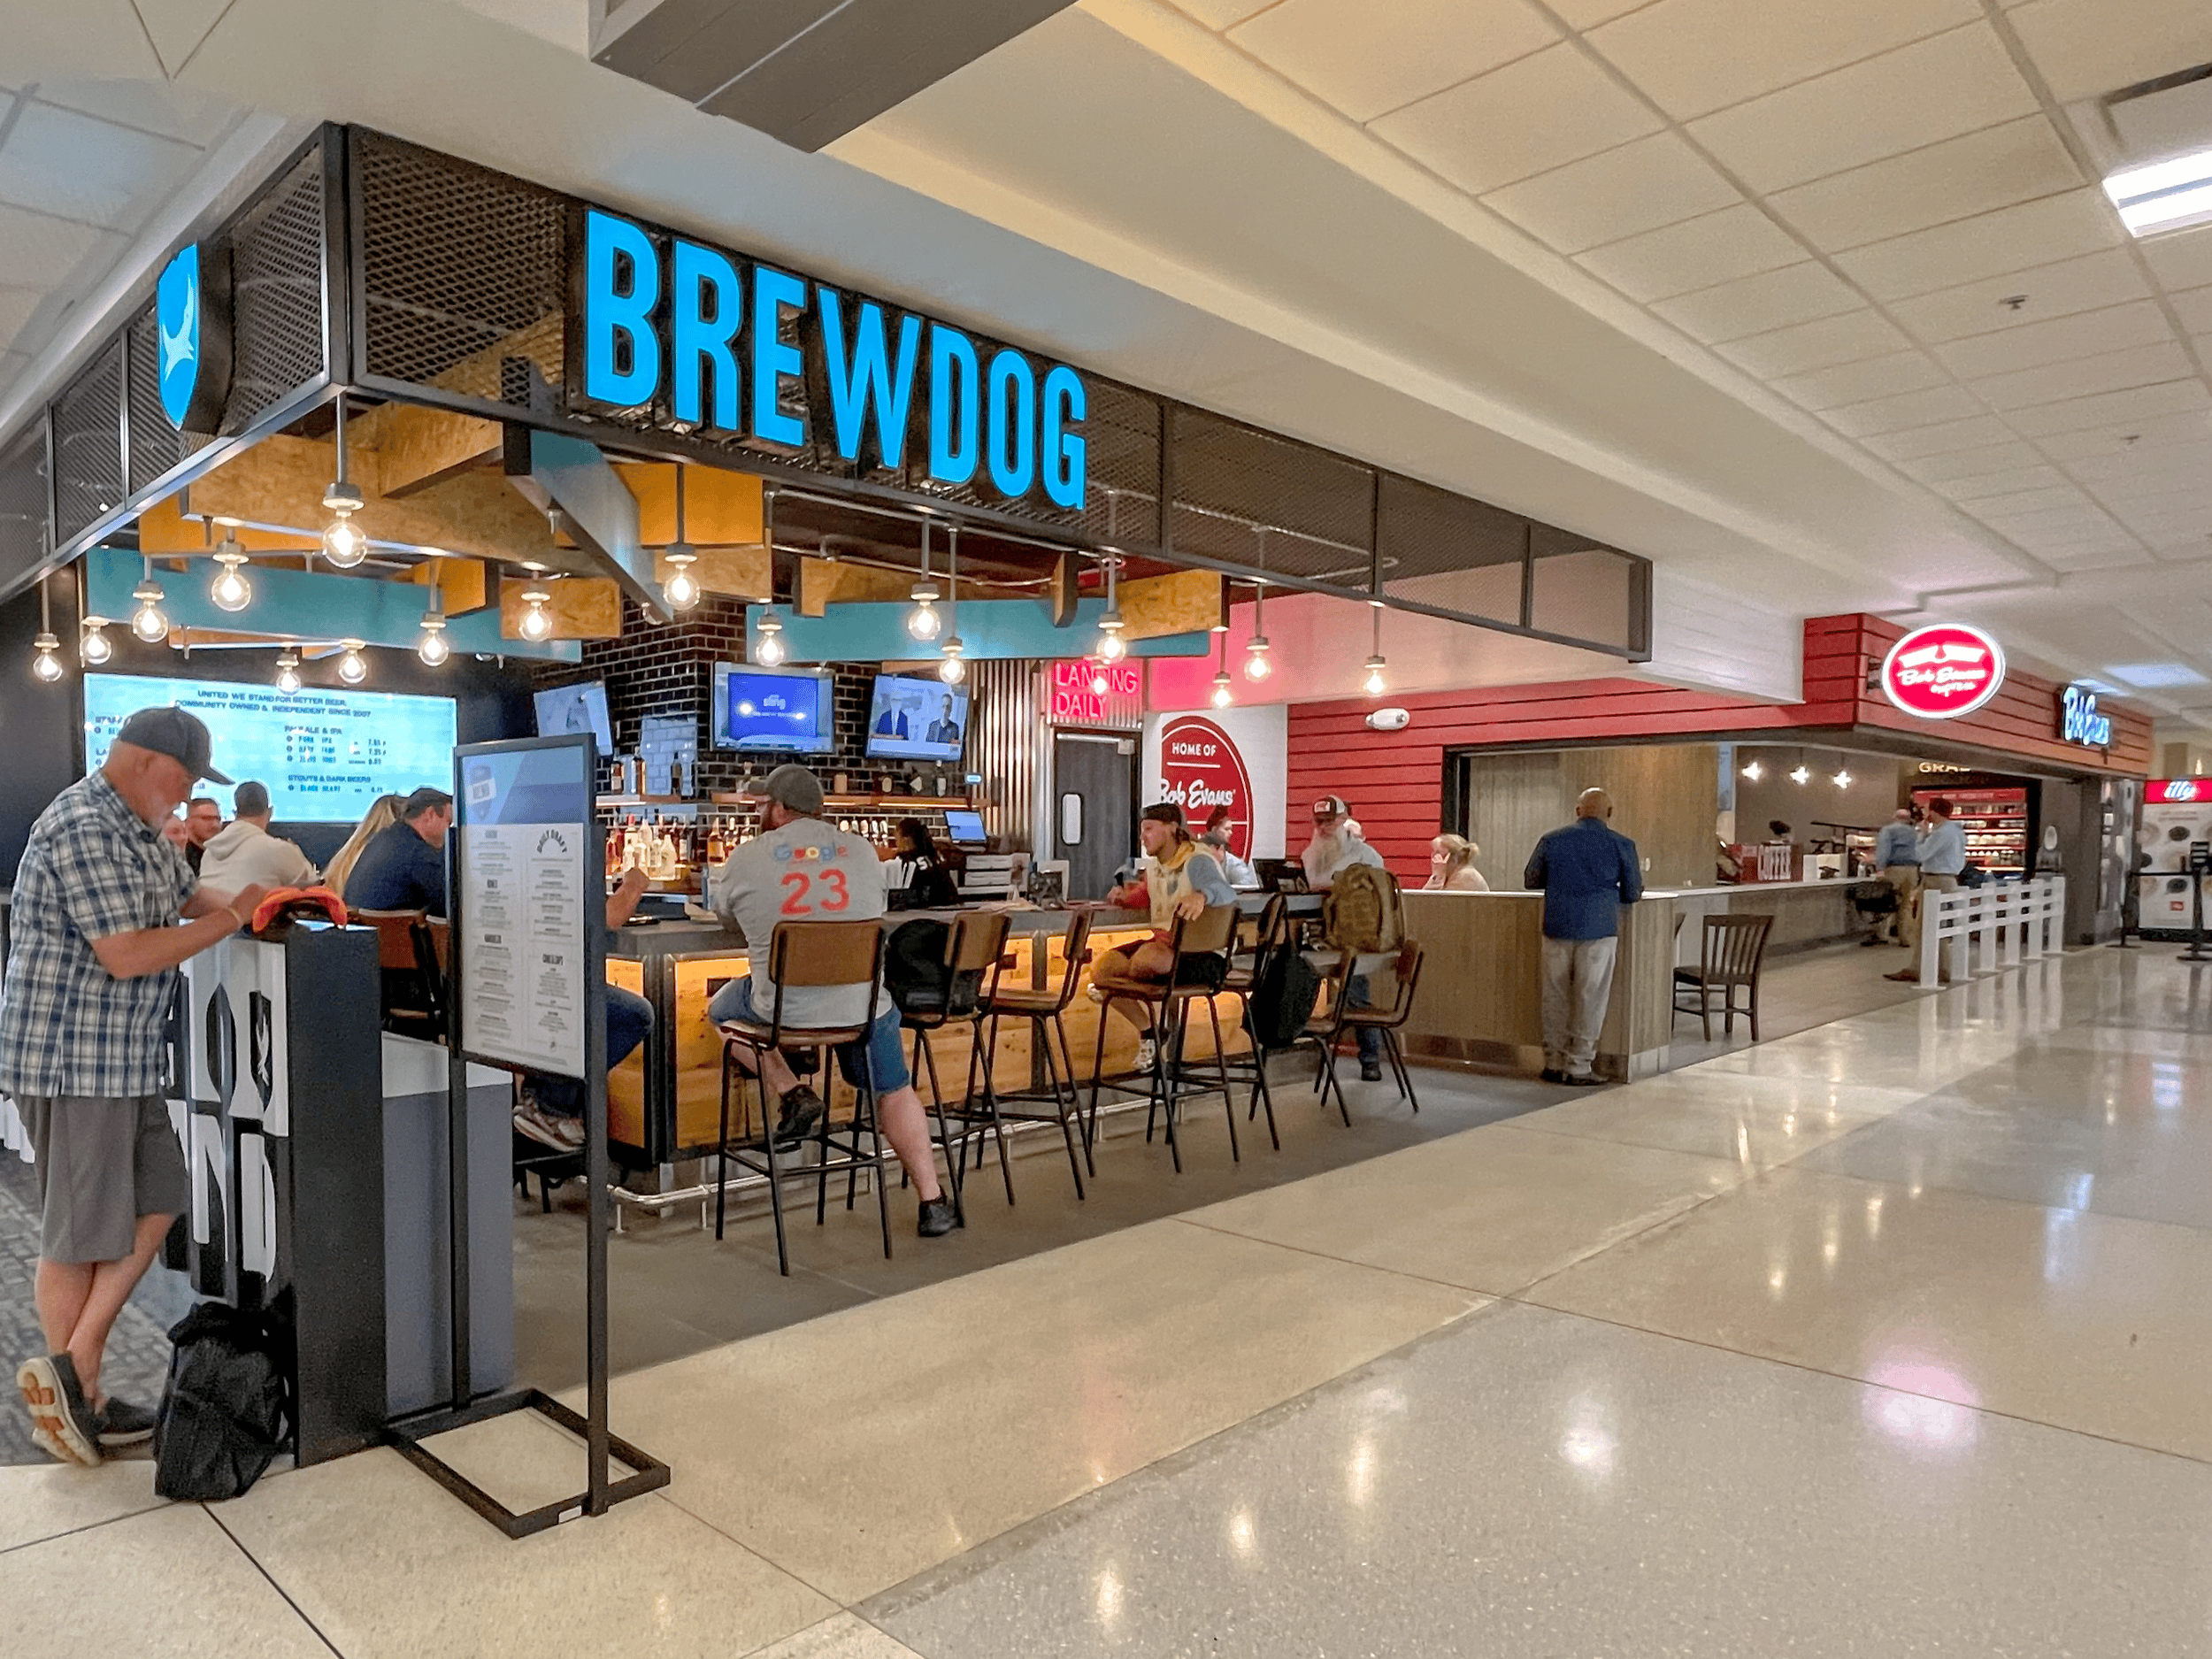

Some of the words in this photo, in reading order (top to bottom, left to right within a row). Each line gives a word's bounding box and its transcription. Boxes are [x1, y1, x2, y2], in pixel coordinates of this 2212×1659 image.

[586, 209, 1087, 511] BREWDOG
[1897, 669, 1935, 686] Bob
[1056, 692, 1107, 718] DAILY
[1171, 742, 1202, 756] HOME
[1203, 744, 1216, 757] OF
[1159, 779, 1187, 805] Bob
[2163, 780, 2197, 801] illy
[773, 841, 849, 863] Google
[780, 869, 849, 915] 23
